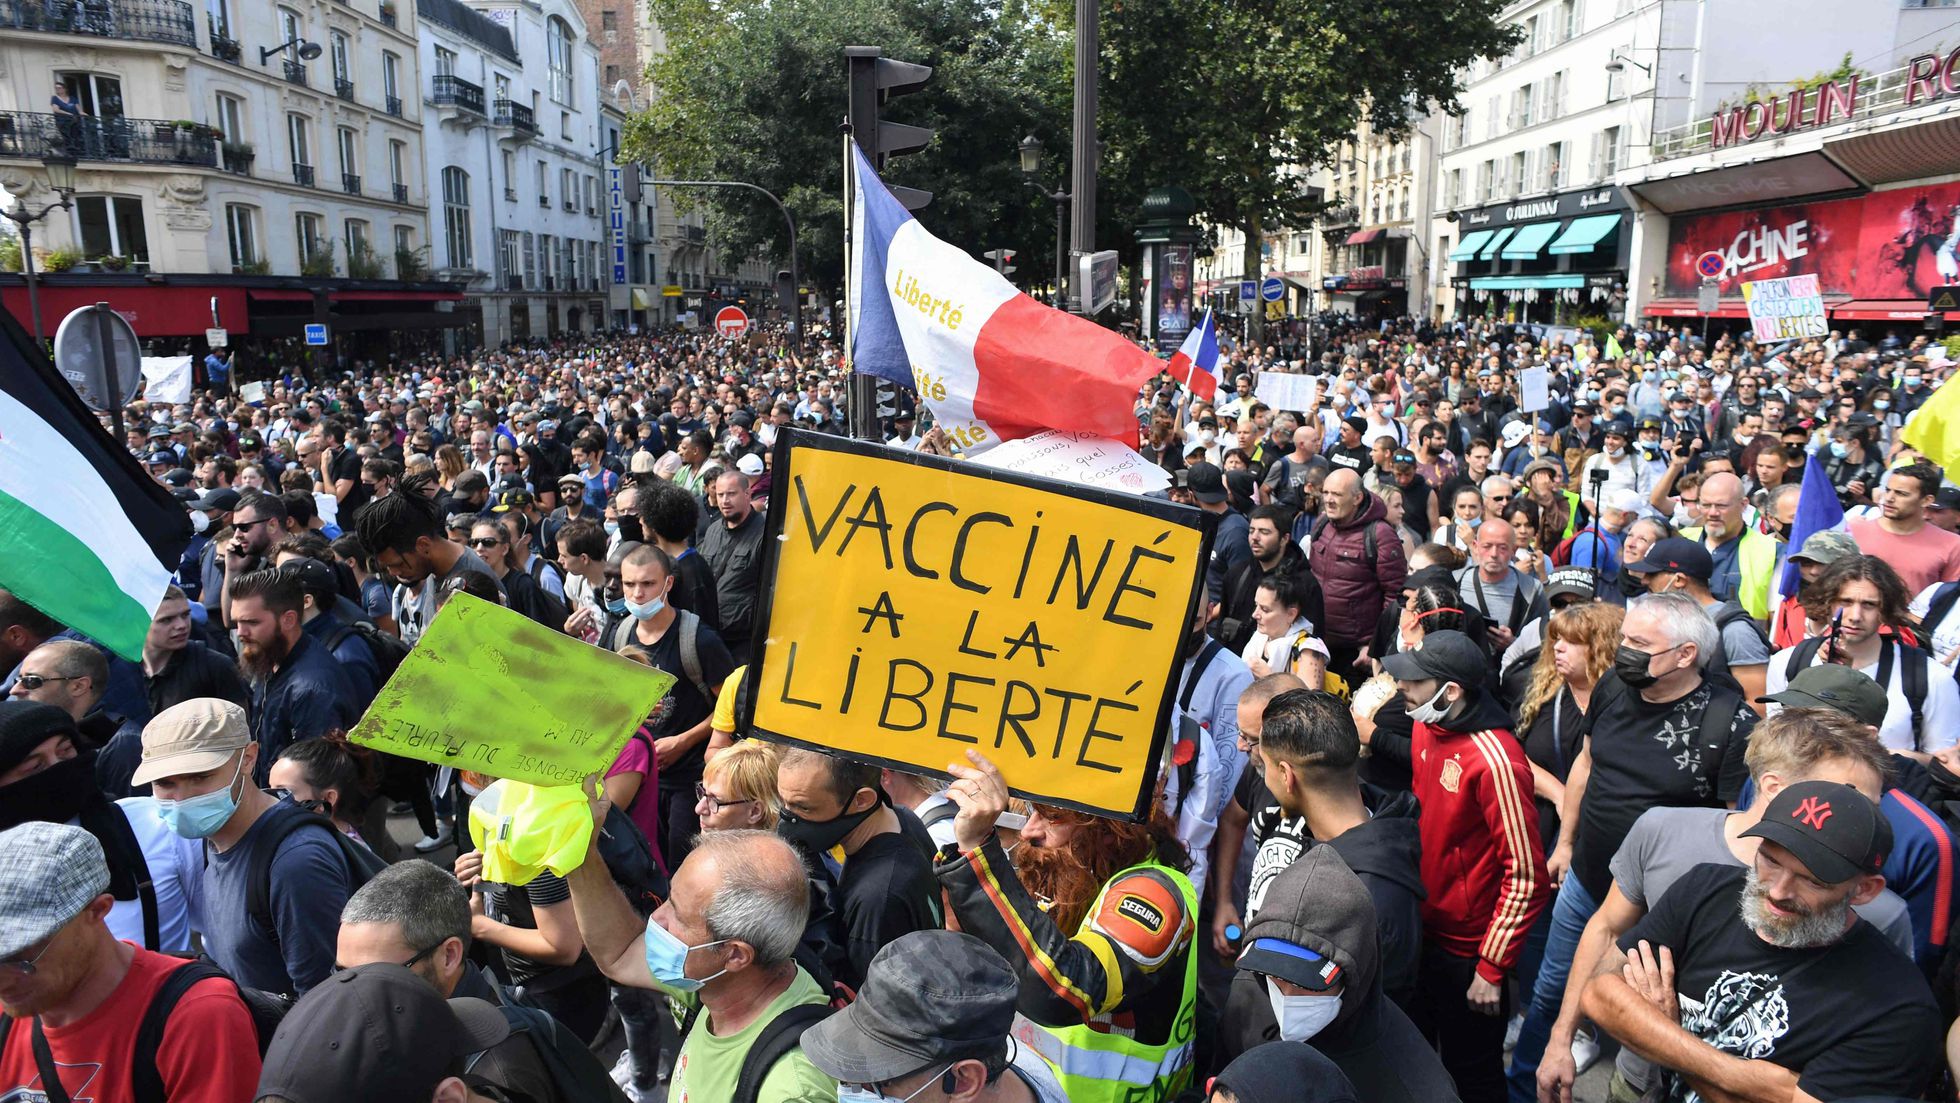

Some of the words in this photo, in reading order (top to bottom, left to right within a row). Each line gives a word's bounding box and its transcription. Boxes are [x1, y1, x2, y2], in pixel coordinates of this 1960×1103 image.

[1710, 75, 1859, 148] MOULIN
[611, 170, 625, 267] HOTEL
[894, 269, 964, 330] Liberté
[912, 364, 947, 402] ité
[1076, 447, 1106, 467] quel
[858, 591, 904, 638] A
[958, 610, 1060, 668] LA
[473, 742, 502, 765] DU
[569, 728, 593, 743] AU
[1120, 899, 1160, 928] SEGURA
